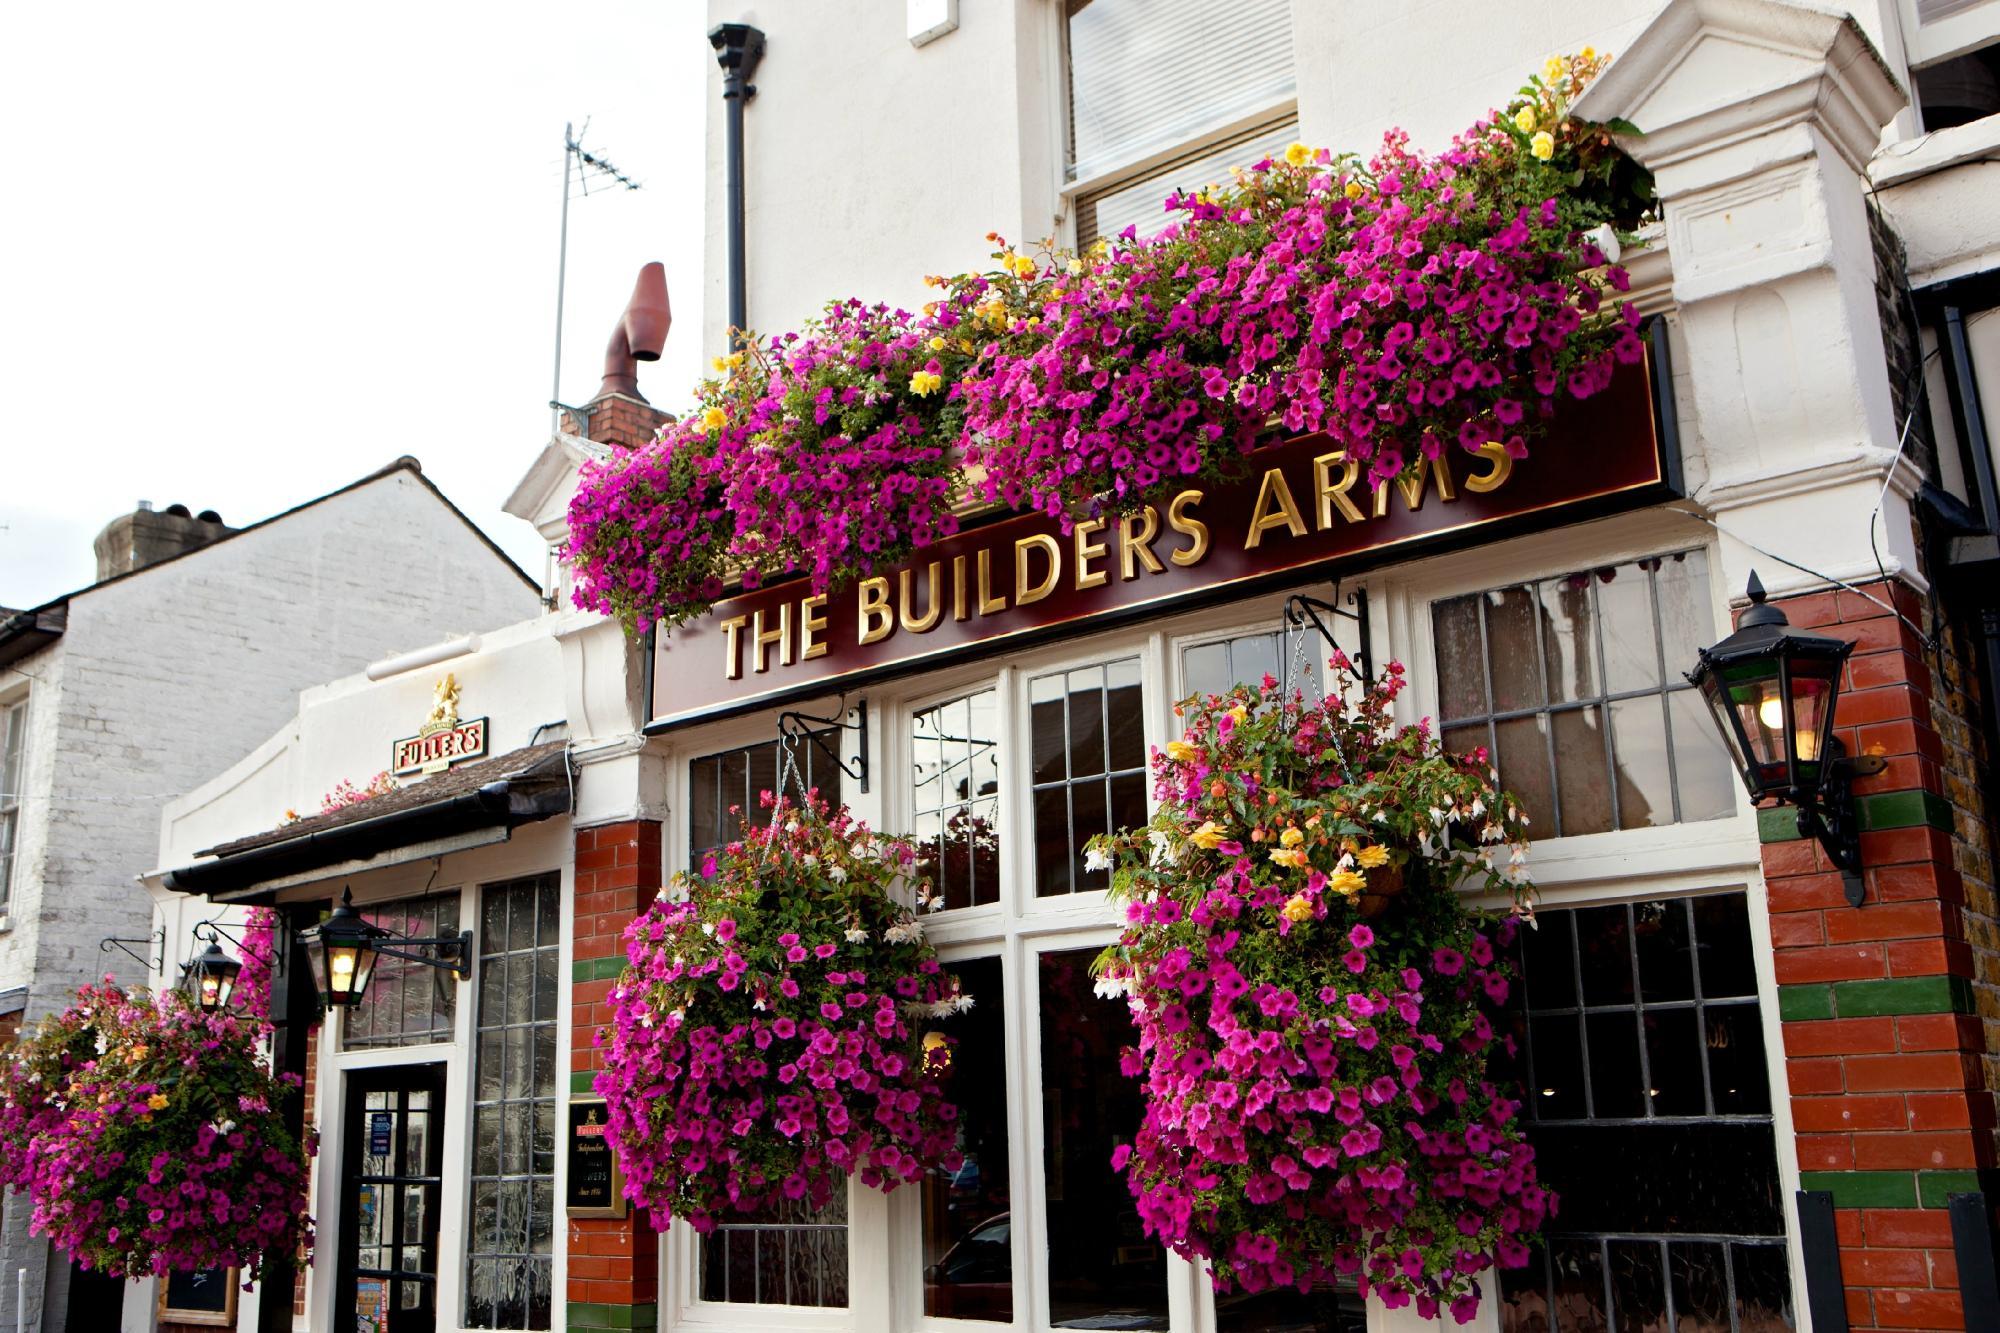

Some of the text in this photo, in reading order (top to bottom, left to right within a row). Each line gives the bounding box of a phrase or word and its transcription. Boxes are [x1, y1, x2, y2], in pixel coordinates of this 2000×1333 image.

[720, 426, 1513, 679] THE BUILDERS ARMS
[397, 727, 477, 770] FULLER'S
